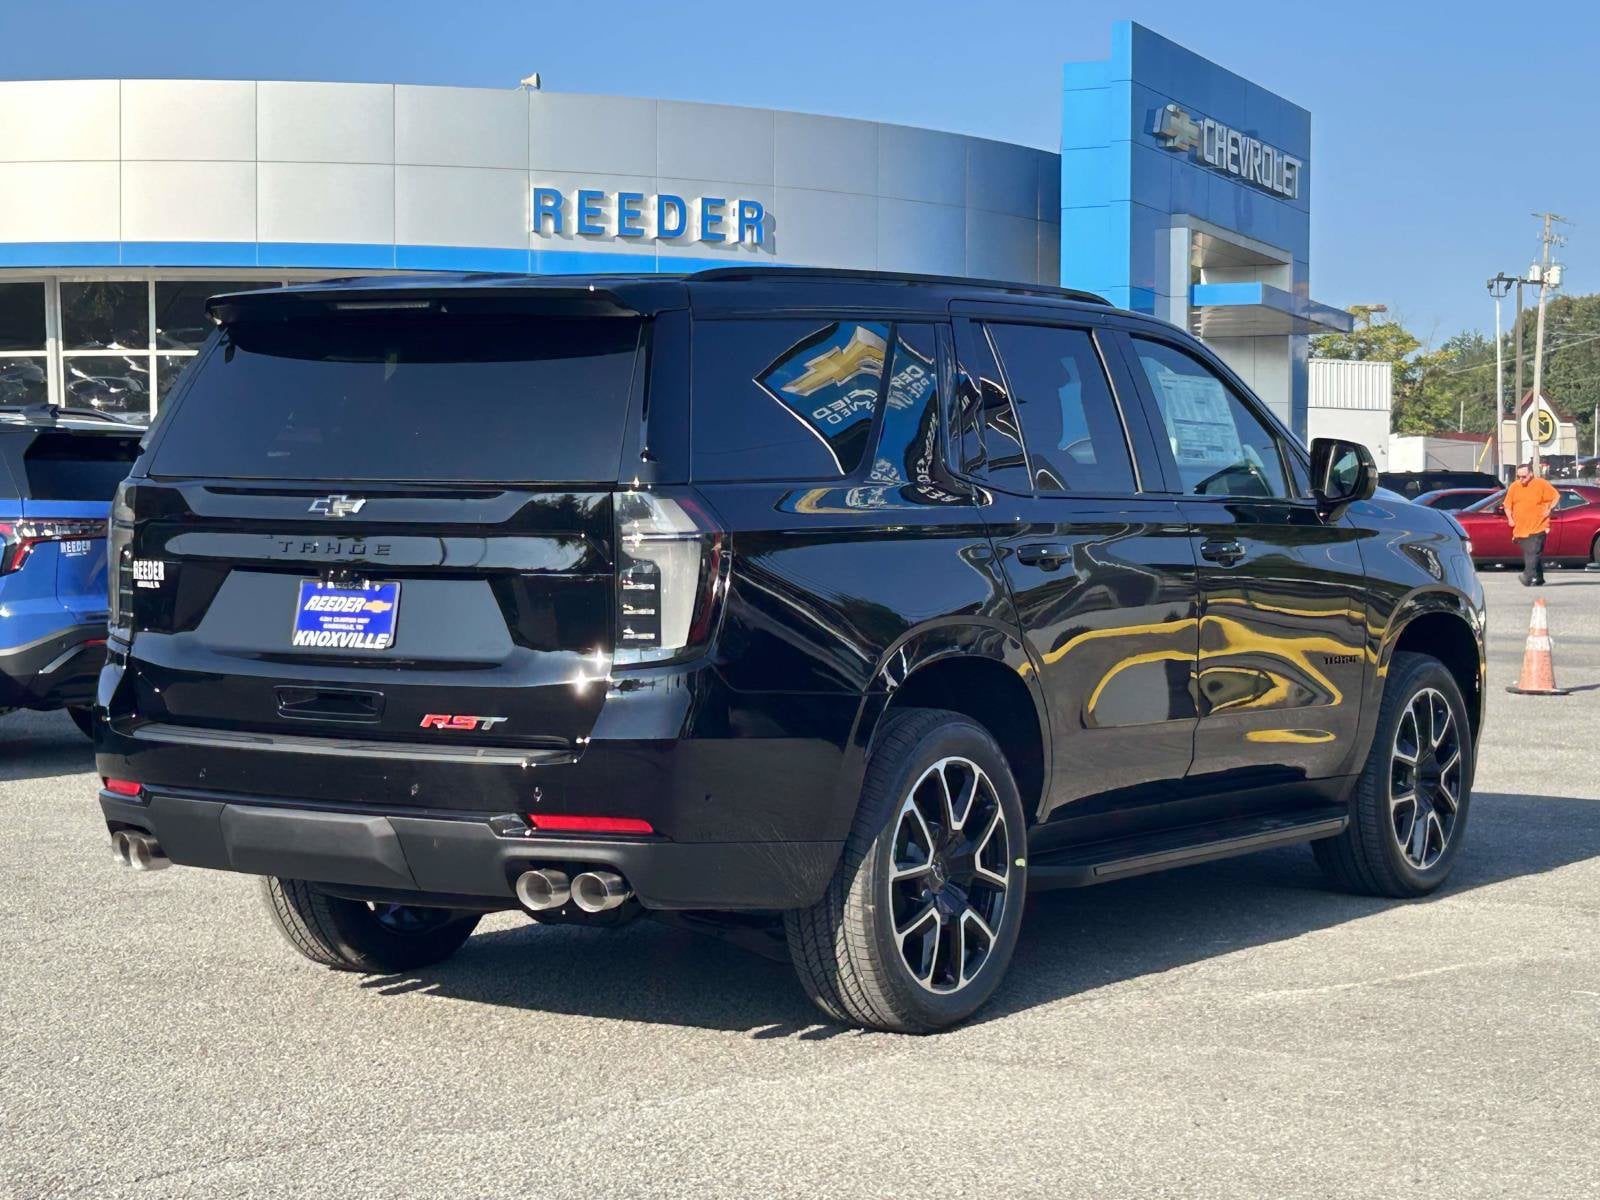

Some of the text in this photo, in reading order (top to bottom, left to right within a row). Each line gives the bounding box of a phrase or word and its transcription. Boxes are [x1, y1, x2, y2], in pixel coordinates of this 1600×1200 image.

[1203, 118, 1303, 199] CHEVROLET
[532, 187, 766, 246] REEDER
[278, 541, 391, 556] TAHOE
[133, 560, 165, 580] REEDER
[304, 595, 367, 613] REEDER
[292, 630, 390, 649] KNOXVILLE
[420, 714, 508, 730] RST
